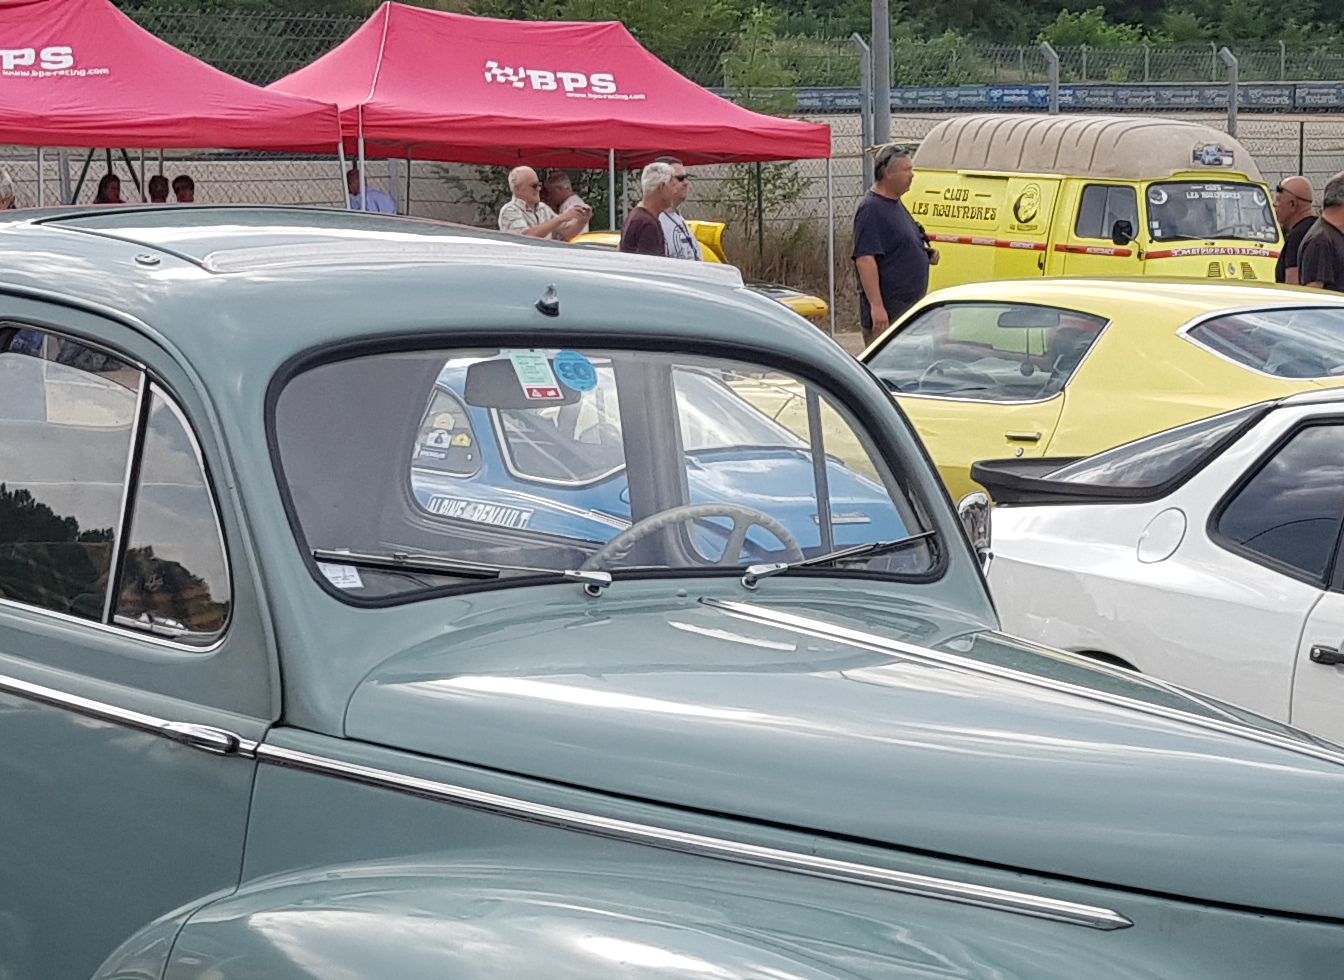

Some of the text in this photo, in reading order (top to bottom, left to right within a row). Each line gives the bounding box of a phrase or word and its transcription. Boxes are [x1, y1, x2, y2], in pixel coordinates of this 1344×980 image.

[526, 69, 618, 93] BPS
[943, 187, 970, 202] CLUB
[912, 202, 997, 220] LES ROULYNDRES
[473, 503, 532, 529] RENAULT
